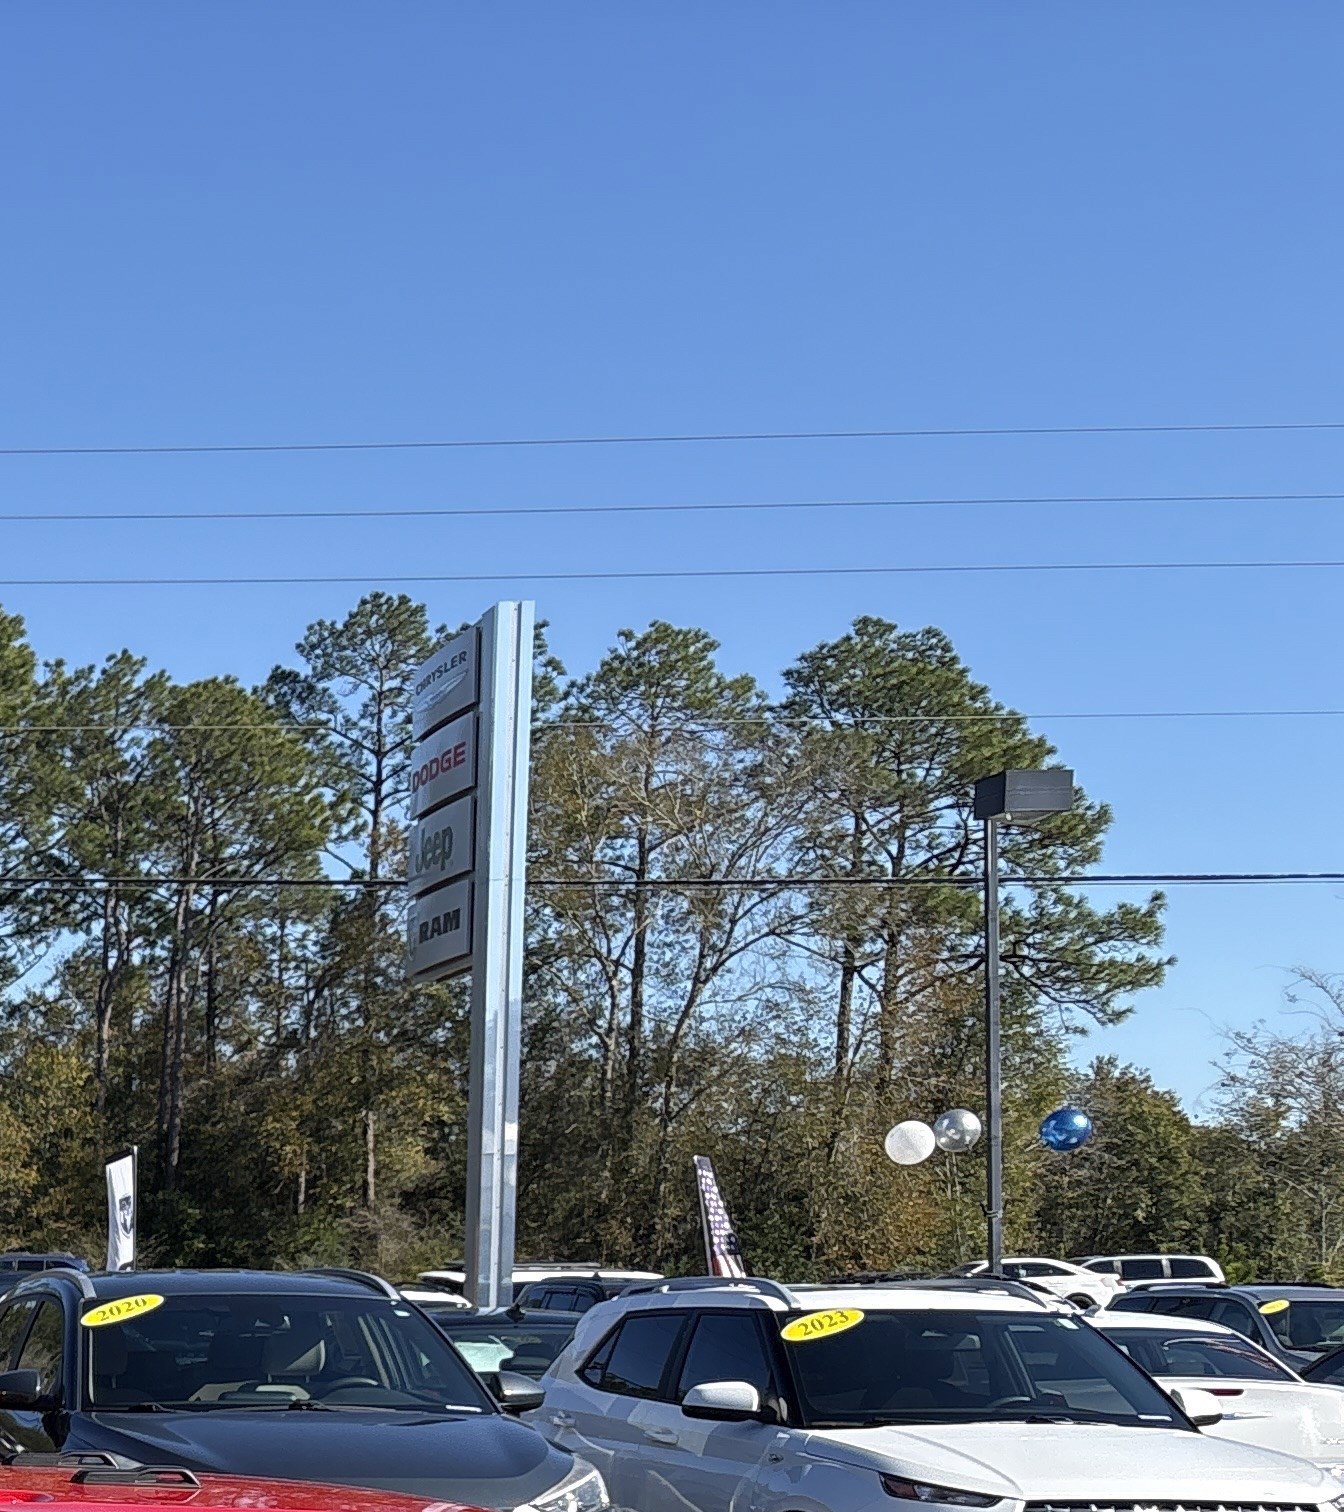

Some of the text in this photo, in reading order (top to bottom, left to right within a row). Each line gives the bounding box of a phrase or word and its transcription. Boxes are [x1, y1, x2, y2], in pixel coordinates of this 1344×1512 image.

[415, 651, 467, 696] CHRYSLER
[412, 741, 466, 794] DODGE
[415, 826, 453, 873] Jeep
[419, 907, 461, 944] RAM
[96, 1298, 147, 1321] 2020
[798, 1310, 849, 1336] 2023
